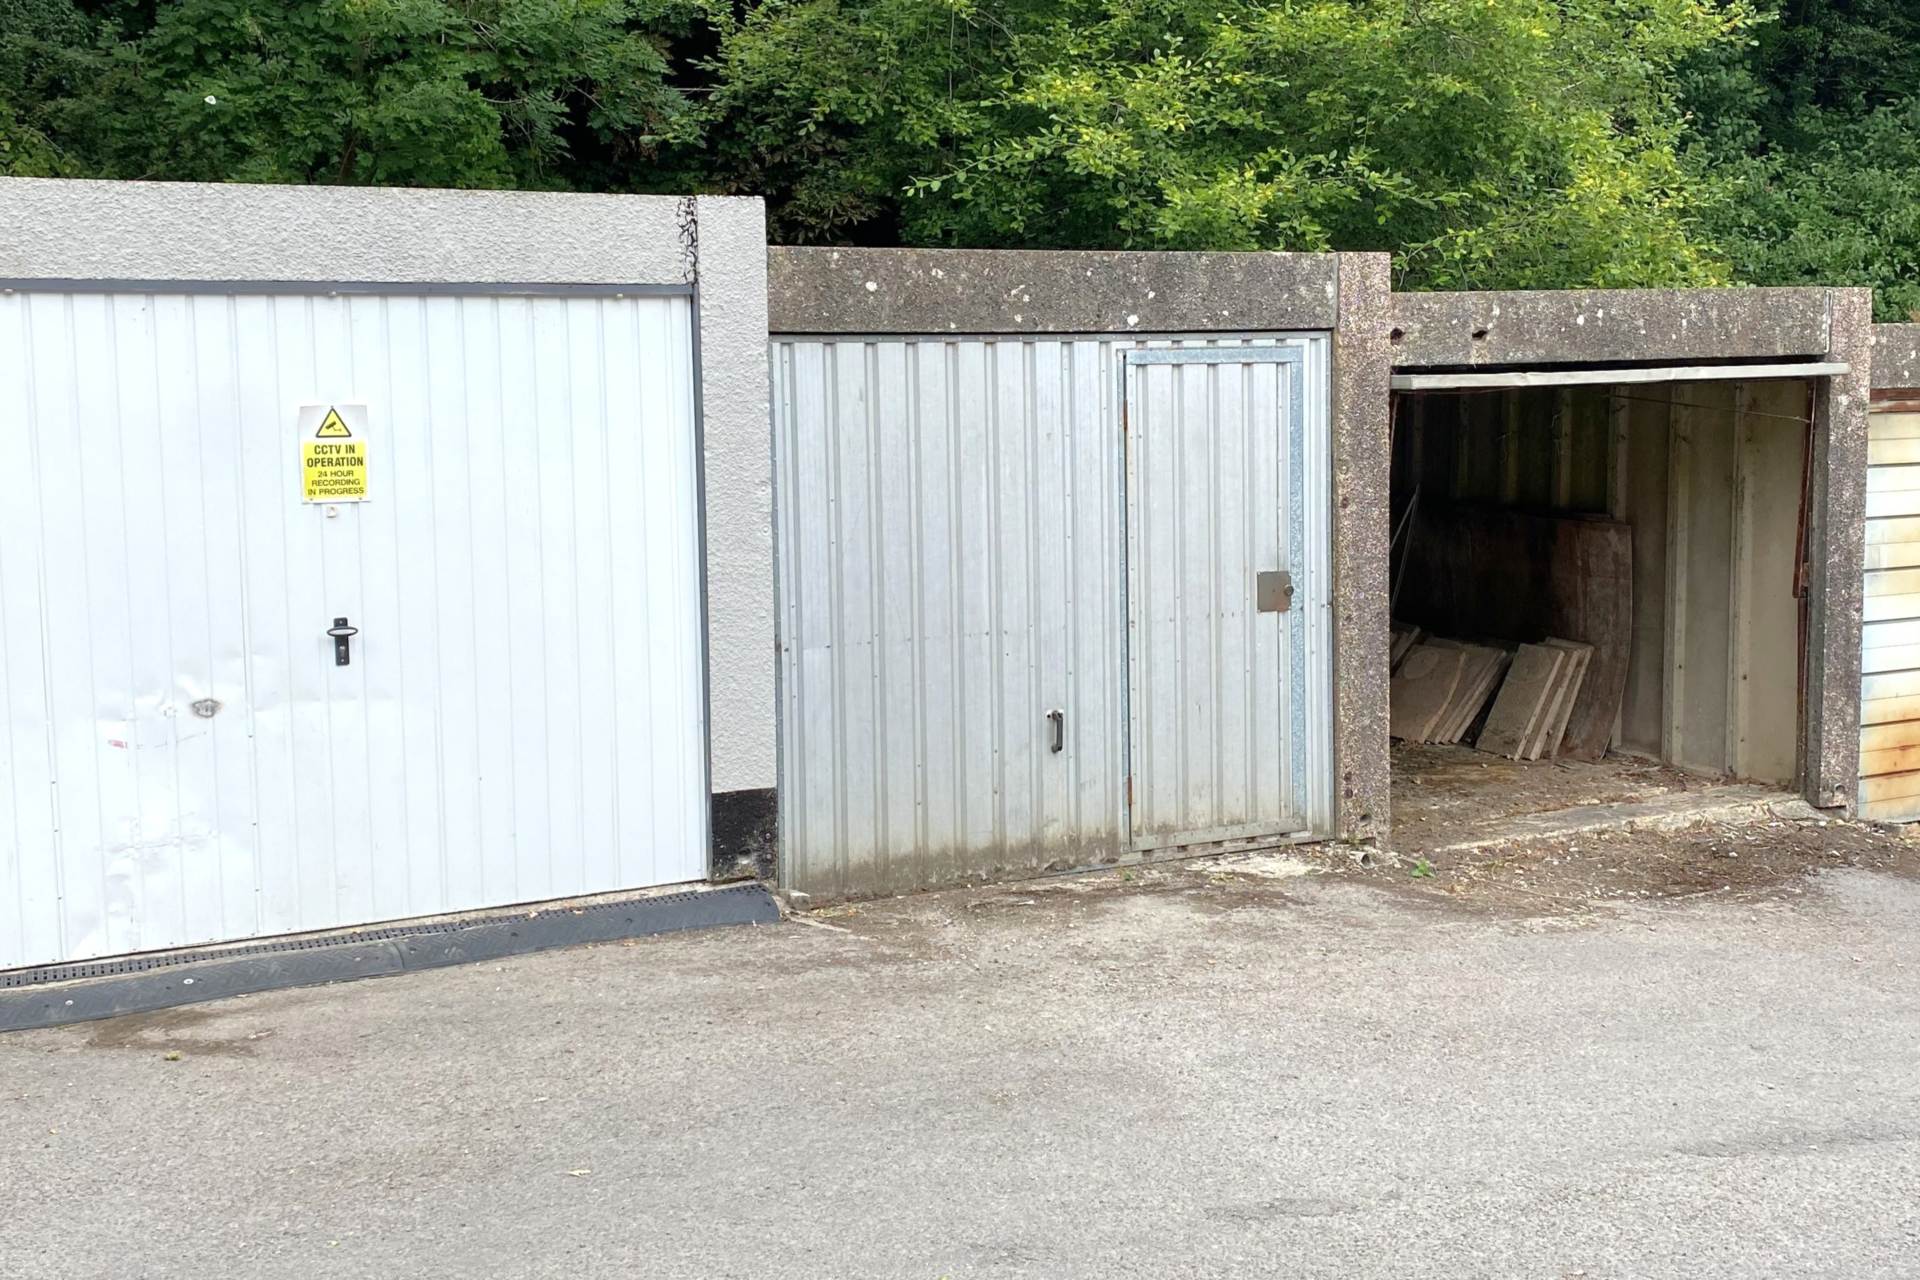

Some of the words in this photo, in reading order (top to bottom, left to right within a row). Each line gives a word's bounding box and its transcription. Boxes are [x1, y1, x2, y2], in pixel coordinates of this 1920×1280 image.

[314, 444, 341, 455] CCTV
[345, 444, 355, 454] IN
[307, 456, 364, 467] OPERATION
[317, 470, 328, 478] 24
[311, 478, 361, 487] RECORDING
[307, 488, 316, 496] IN
[319, 487, 364, 495] PROGRESS
